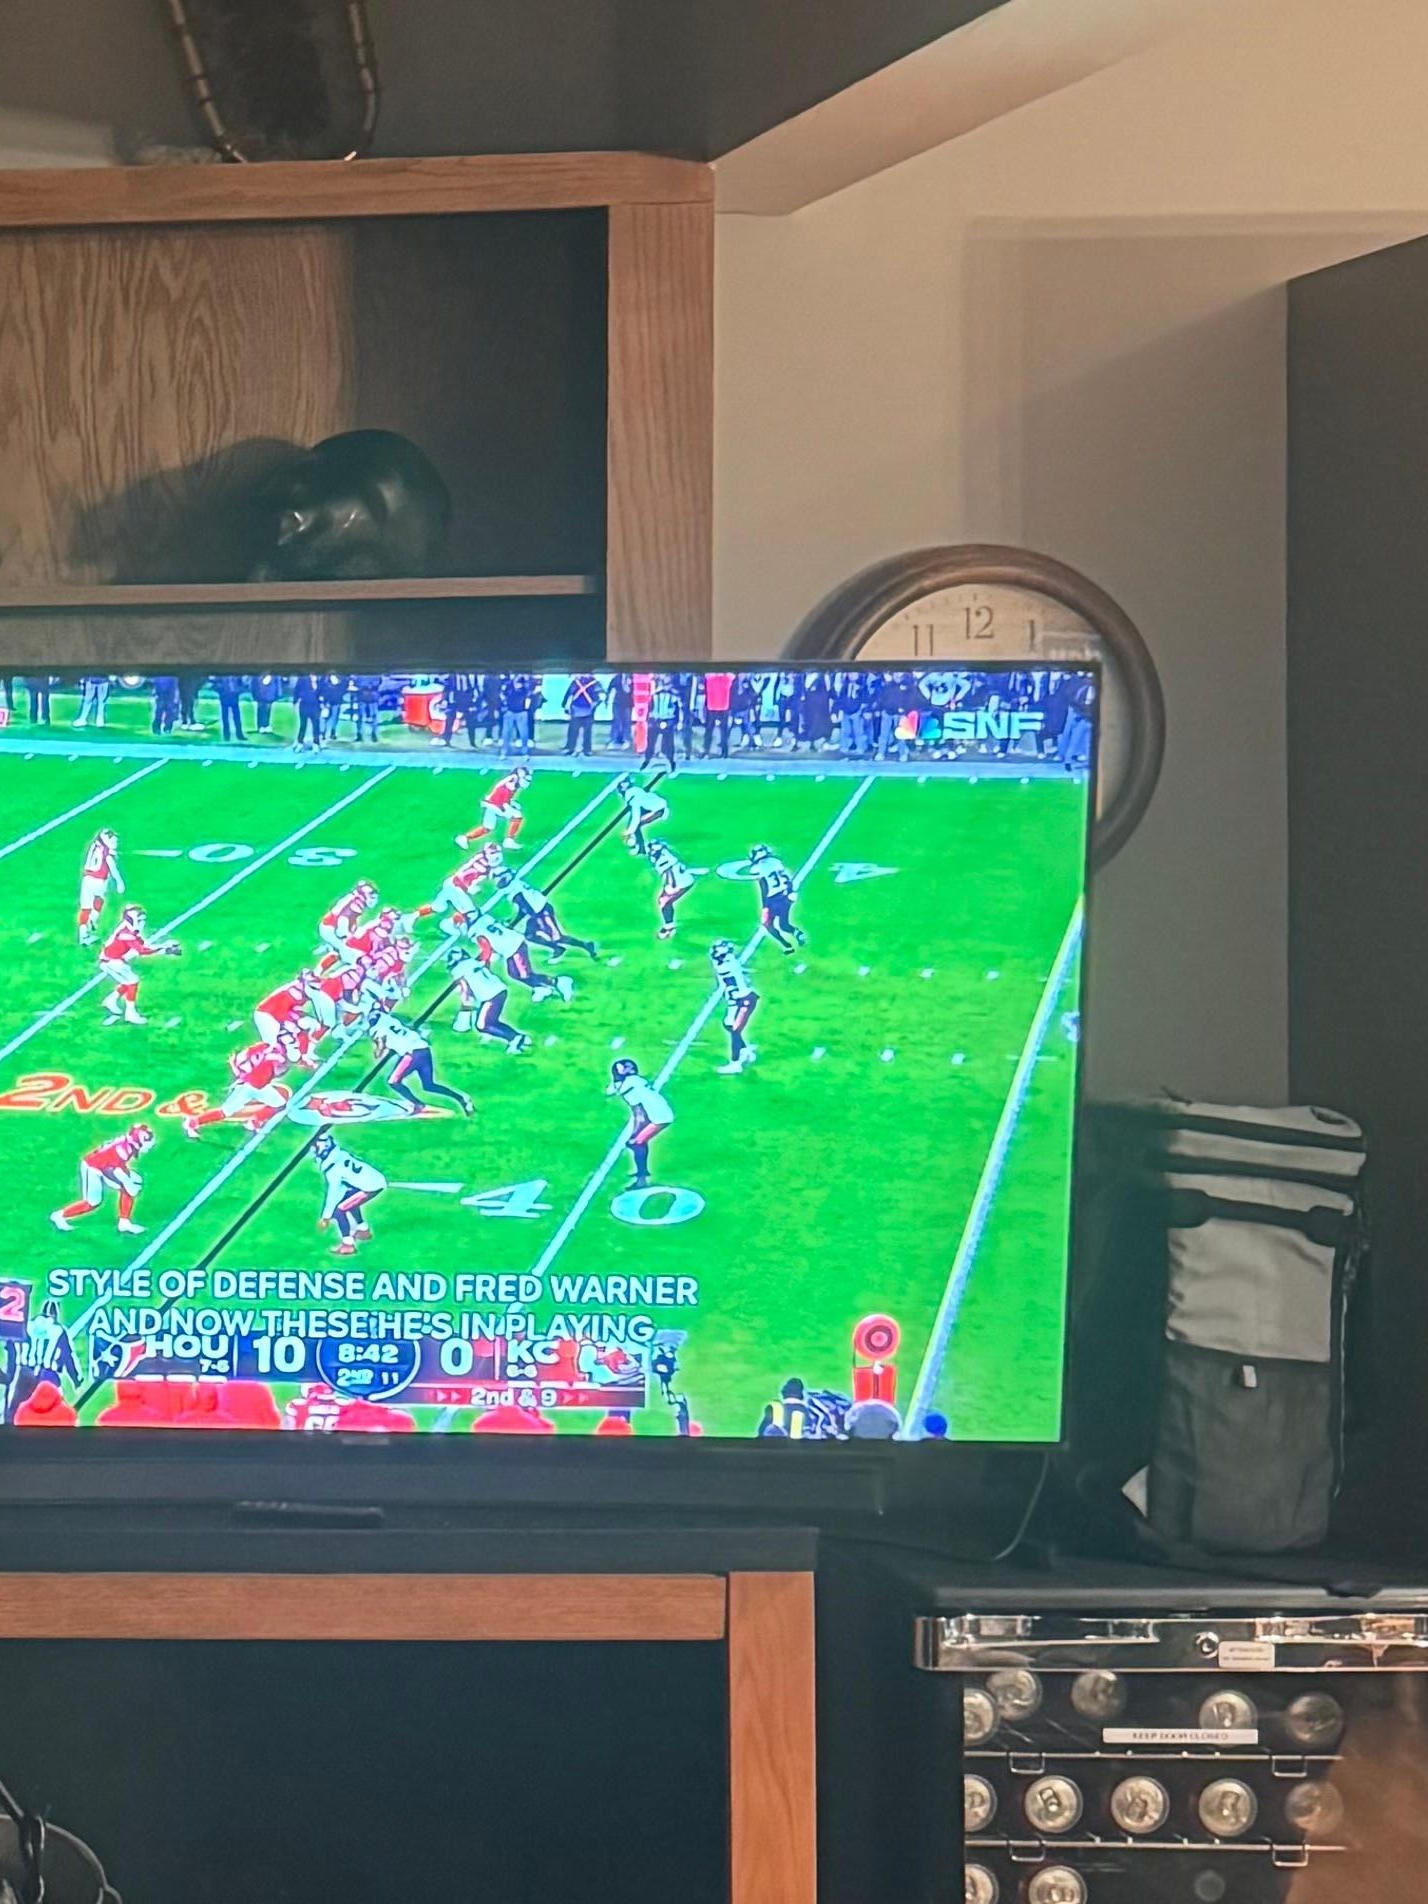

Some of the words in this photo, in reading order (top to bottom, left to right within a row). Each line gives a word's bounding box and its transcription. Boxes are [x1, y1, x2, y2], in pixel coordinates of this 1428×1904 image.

[964, 605, 994, 639] 12
[911, 623, 935, 656] 11
[943, 711, 1044, 740] SNF
[48, 1268, 151, 1297] STYLE
[159, 1269, 206, 1298] OF
[214, 1271, 365, 1300] DEFENSE
[372, 1272, 446, 1302] AND
[455, 1273, 542, 1303] FRED
[550, 1275, 699, 1305] WARNER
[89, 1307, 163, 1335] AND
[170, 1308, 254, 1337] NOW
[262, 1309, 369, 1339] THESE
[462, 1312, 496, 1341] IN
[505, 1313, 655, 1344] PLAYING
[145, 1333, 230, 1359] HOU
[253, 1335, 306, 1374] 10
[338, 1342, 399, 1364] 8:42
[440, 1337, 474, 1376] 0
[507, 1339, 560, 1365] KC
[381, 1371, 399, 1385] 11
[471, 1387, 514, 1407] 2nd
[541, 1389, 558, 1407] 9
